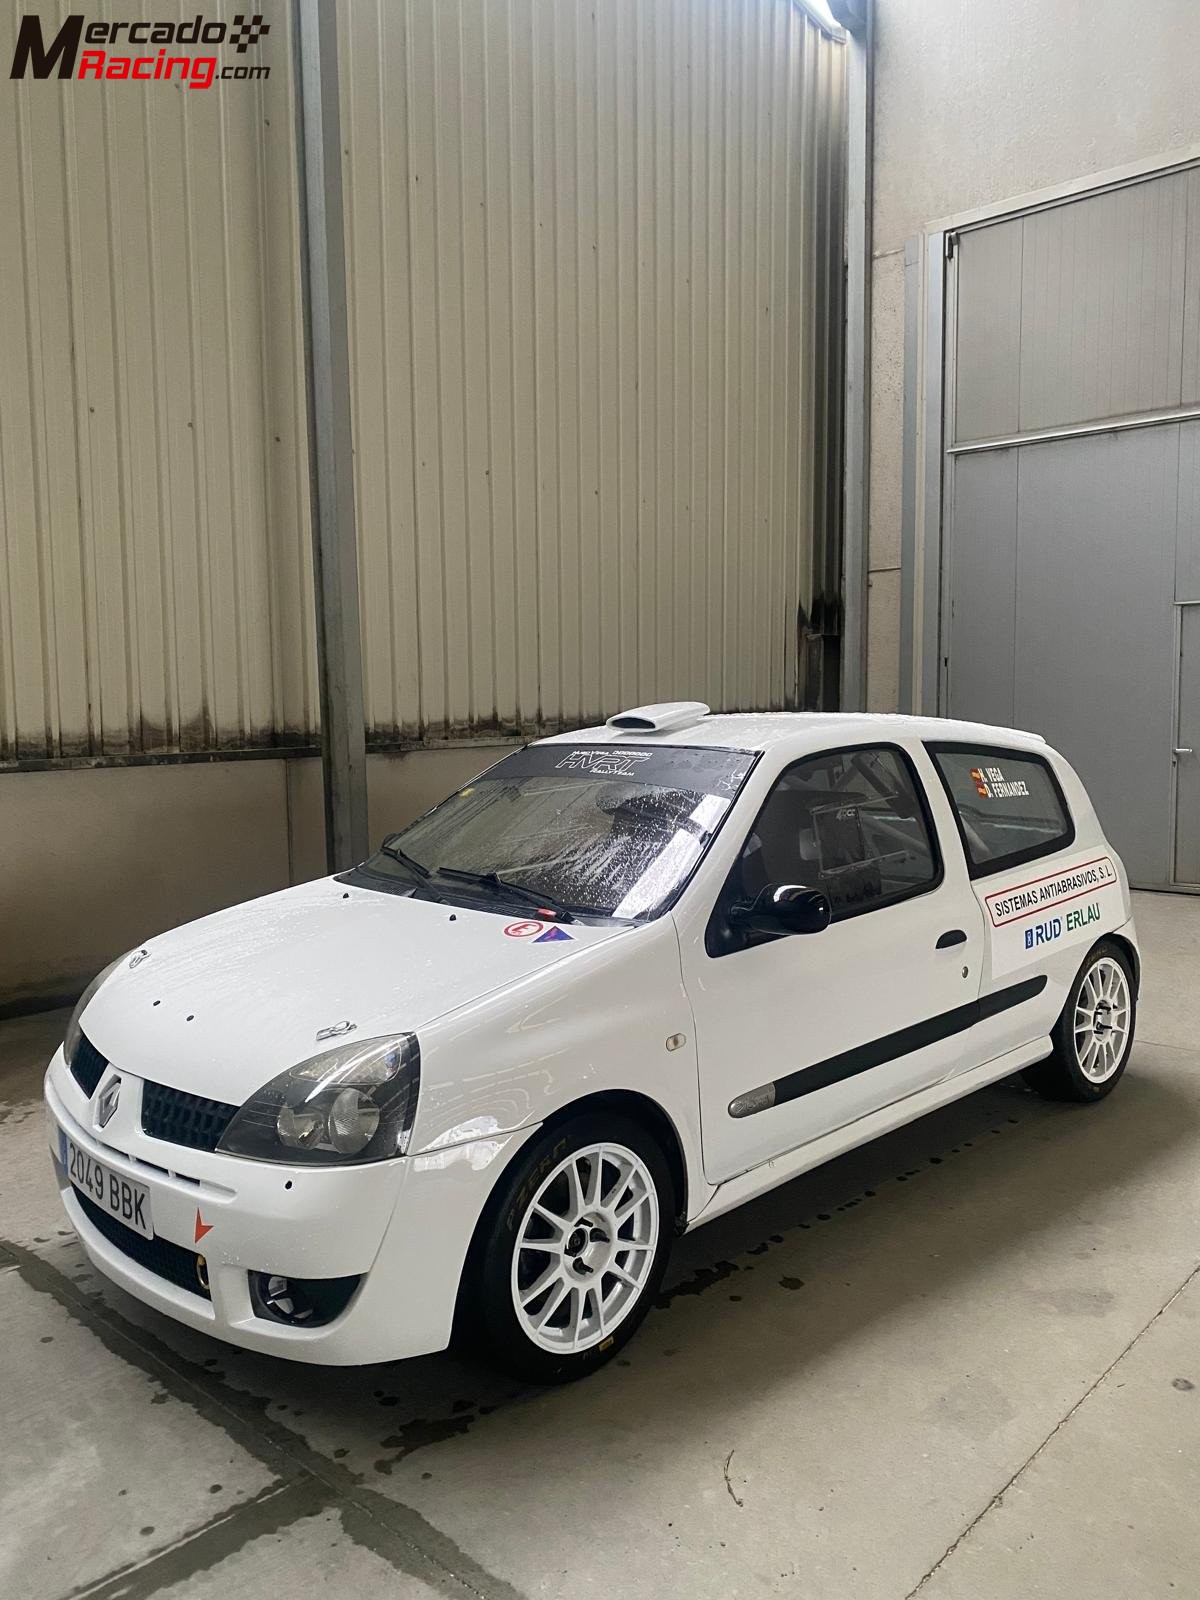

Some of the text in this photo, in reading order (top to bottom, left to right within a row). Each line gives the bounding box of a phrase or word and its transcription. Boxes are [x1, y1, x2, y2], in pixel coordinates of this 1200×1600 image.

[985, 767, 1005, 782] VEGA
[991, 780, 1030, 798] FERNANDEZ
[994, 890, 1038, 917] SISTEMAS
[1039, 869, 1100, 902] ANTIABRASIVOS,
[1035, 902, 1101, 946] RUD ERLAU
[69, 1142, 147, 1230] 2049 BBK
